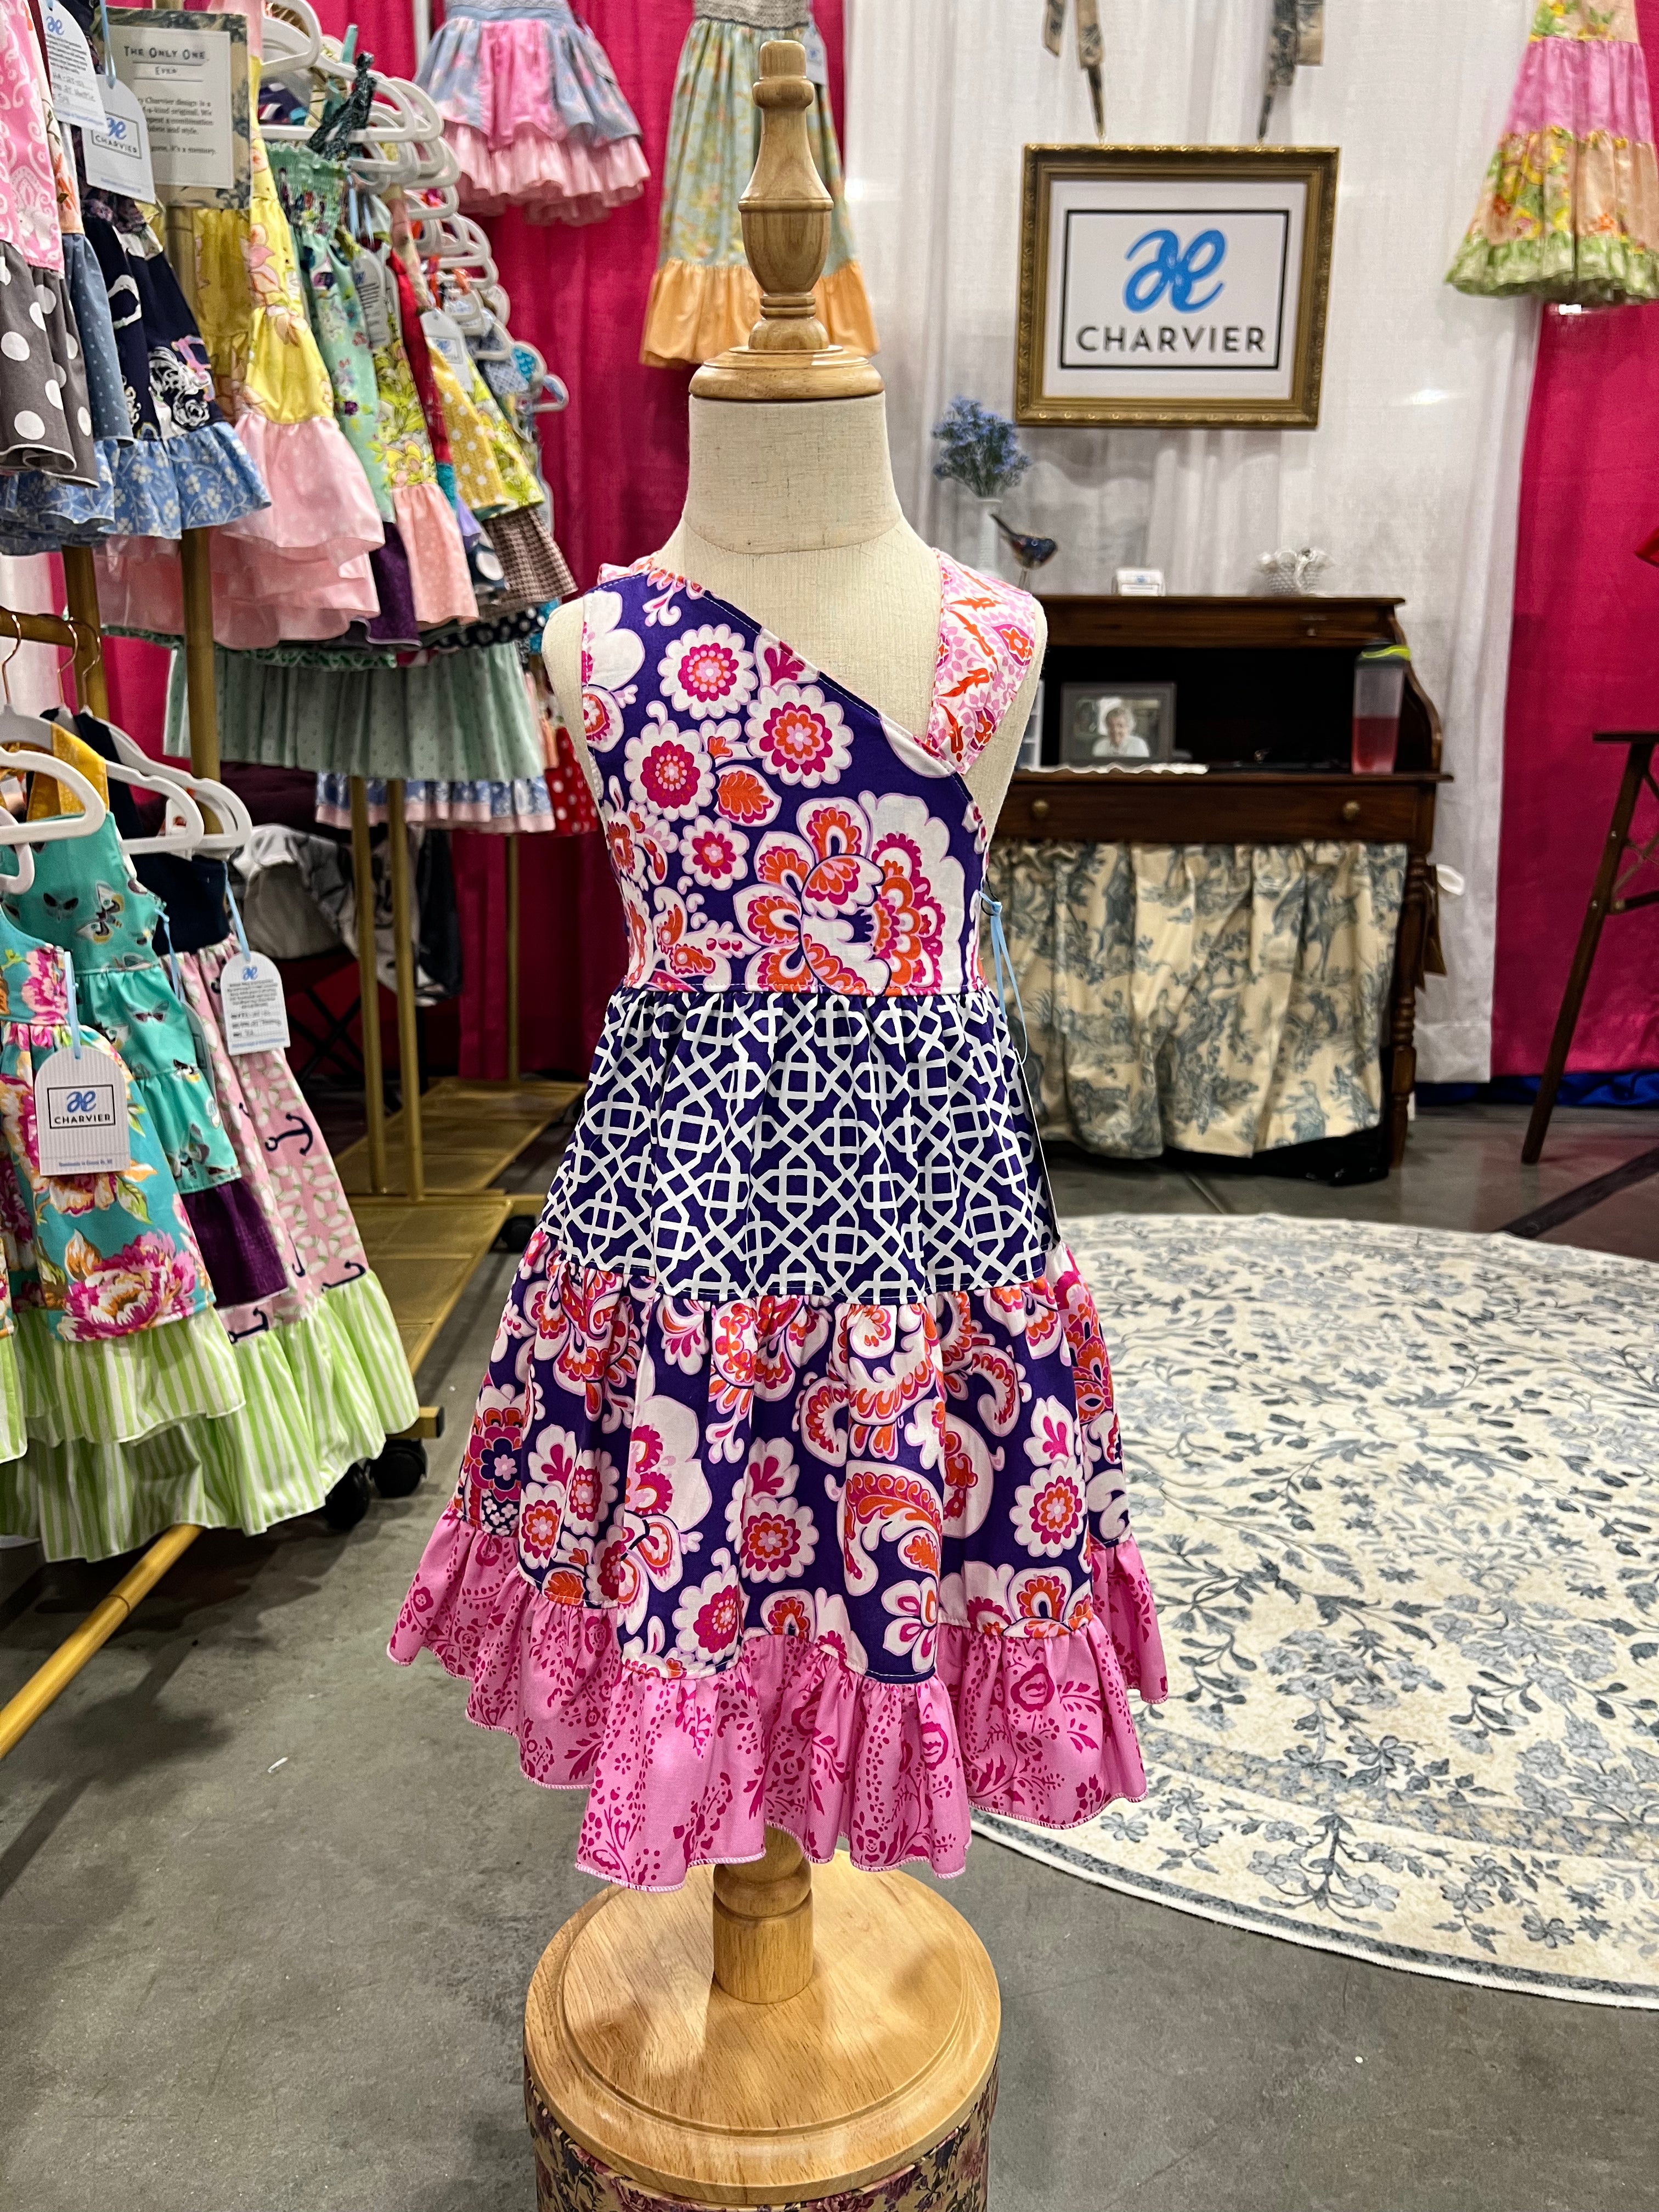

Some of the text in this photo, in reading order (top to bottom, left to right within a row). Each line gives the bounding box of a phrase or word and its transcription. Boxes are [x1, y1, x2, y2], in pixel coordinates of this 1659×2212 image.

[149, 47, 177, 58] ONLY
[1076, 325, 1266, 353] CHARVIER
[54, 1113, 111, 1125] CHARVIER
